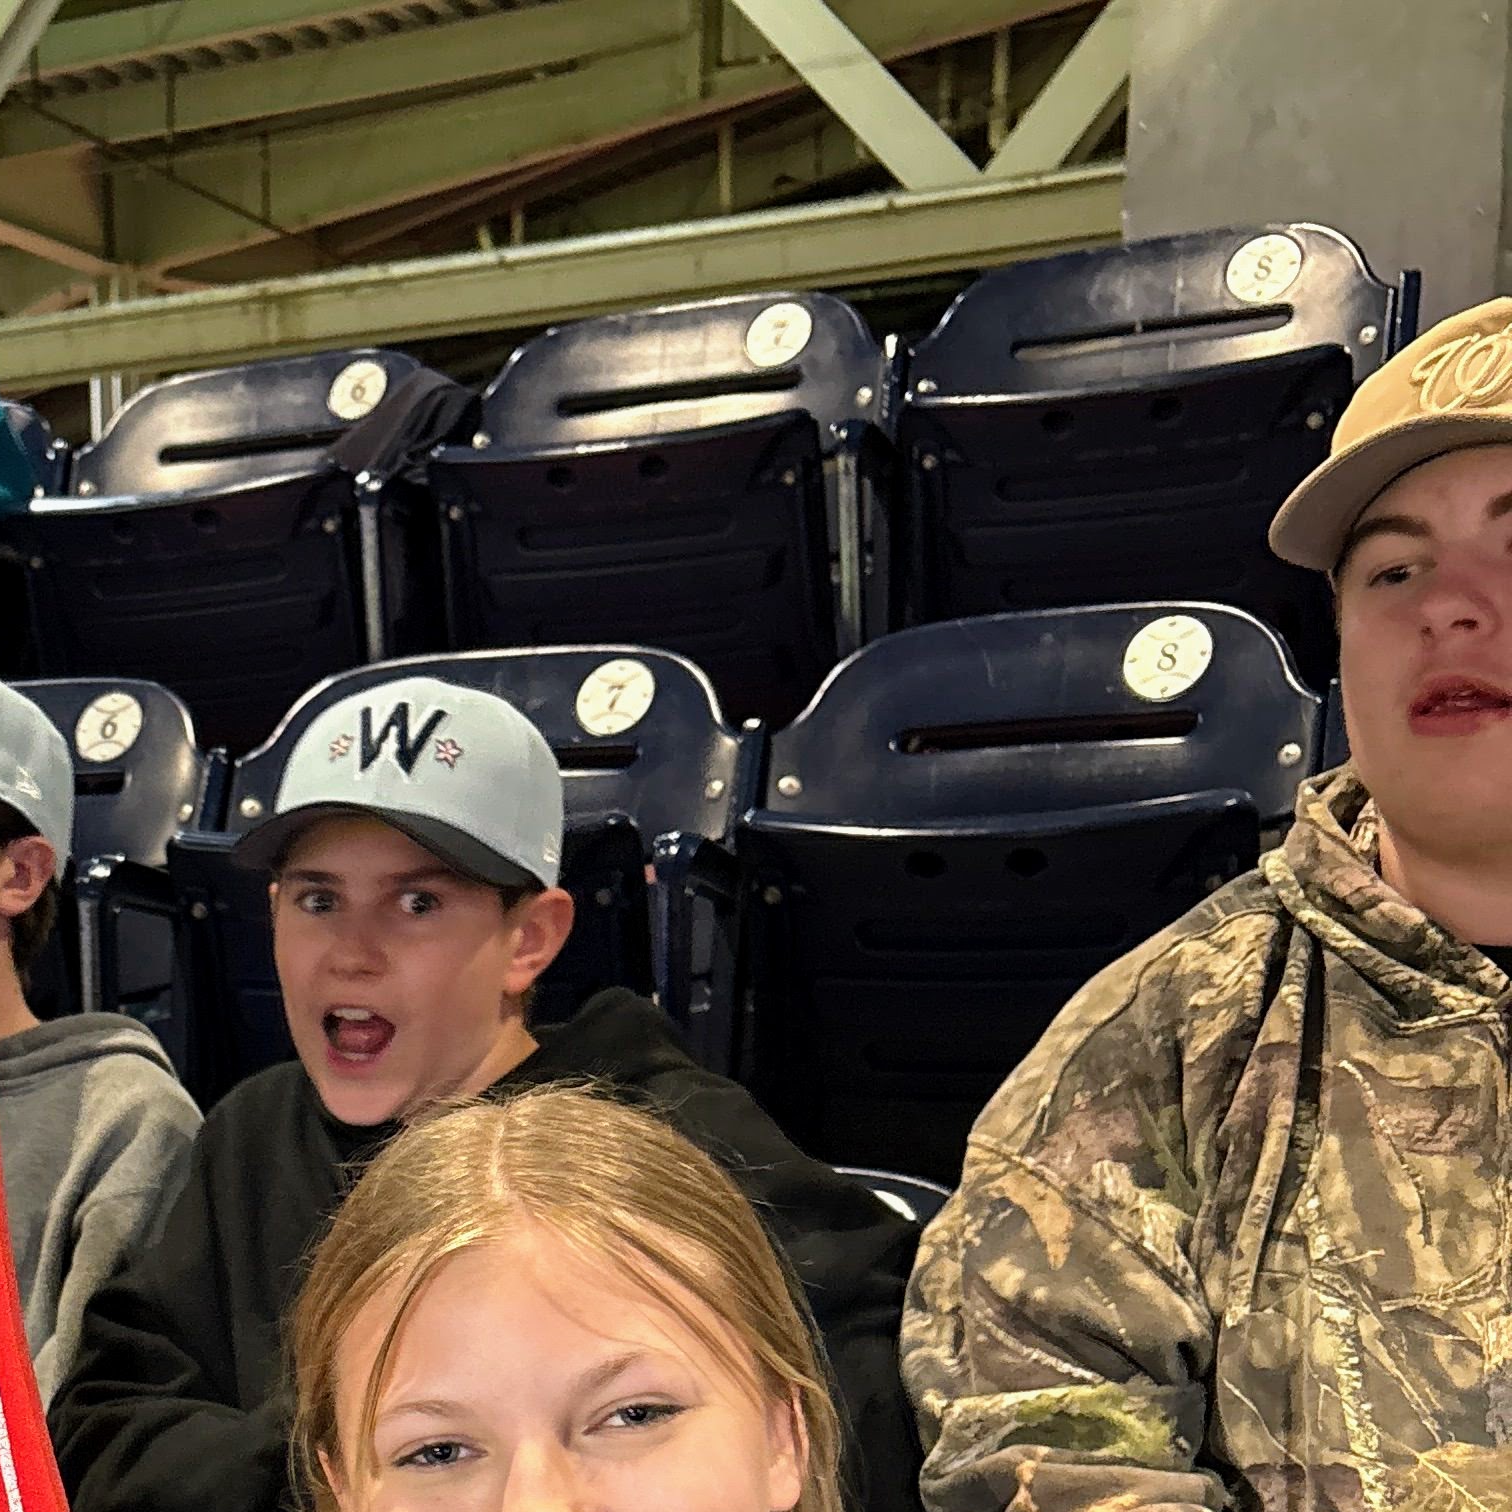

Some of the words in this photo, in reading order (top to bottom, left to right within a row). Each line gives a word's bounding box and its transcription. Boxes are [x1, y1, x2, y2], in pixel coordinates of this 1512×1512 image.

[771, 319, 788, 345] 7
[1156, 643, 1180, 673] 8
[604, 684, 625, 711] 7
[101, 713, 117, 740] 6
[359, 701, 448, 776] W
